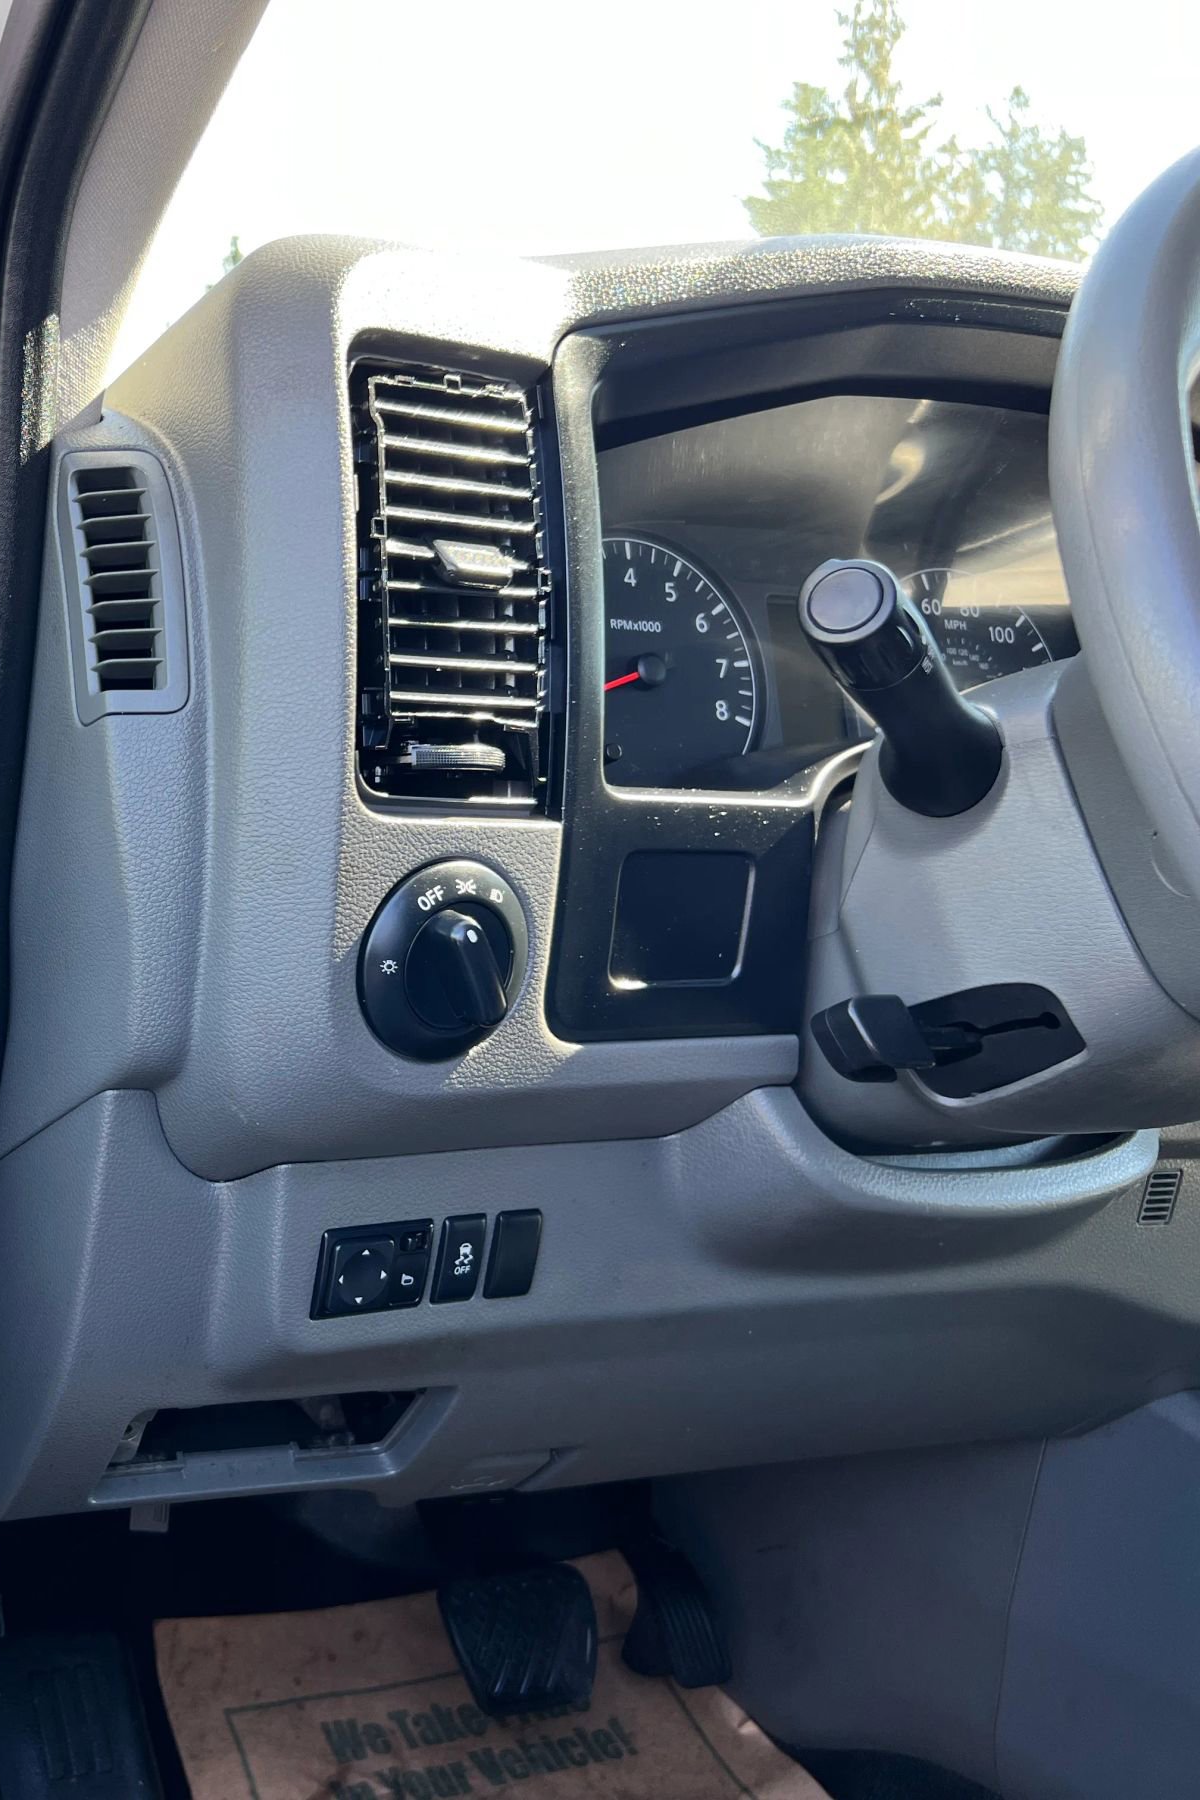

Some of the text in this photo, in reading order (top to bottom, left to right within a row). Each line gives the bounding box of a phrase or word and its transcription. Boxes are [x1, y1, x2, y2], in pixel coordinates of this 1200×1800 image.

[624, 567, 637, 587] 4
[664, 582, 677, 602] 5
[921, 598, 941, 616] 60
[960, 601, 980, 618] 80
[610, 618, 662, 633] RPMx1000
[695, 612, 709, 633] 6
[944, 619, 967, 631] MPH
[988, 626, 1015, 644] 100
[715, 658, 728, 678] 7
[715, 700, 729, 721] 8
[417, 885, 445, 911] OFF
[454, 1265, 471, 1275] OFF
[320, 1718, 391, 1763] We
[387, 1703, 488, 1749] Take
[469, 1716, 638, 1785] Vehicle!
